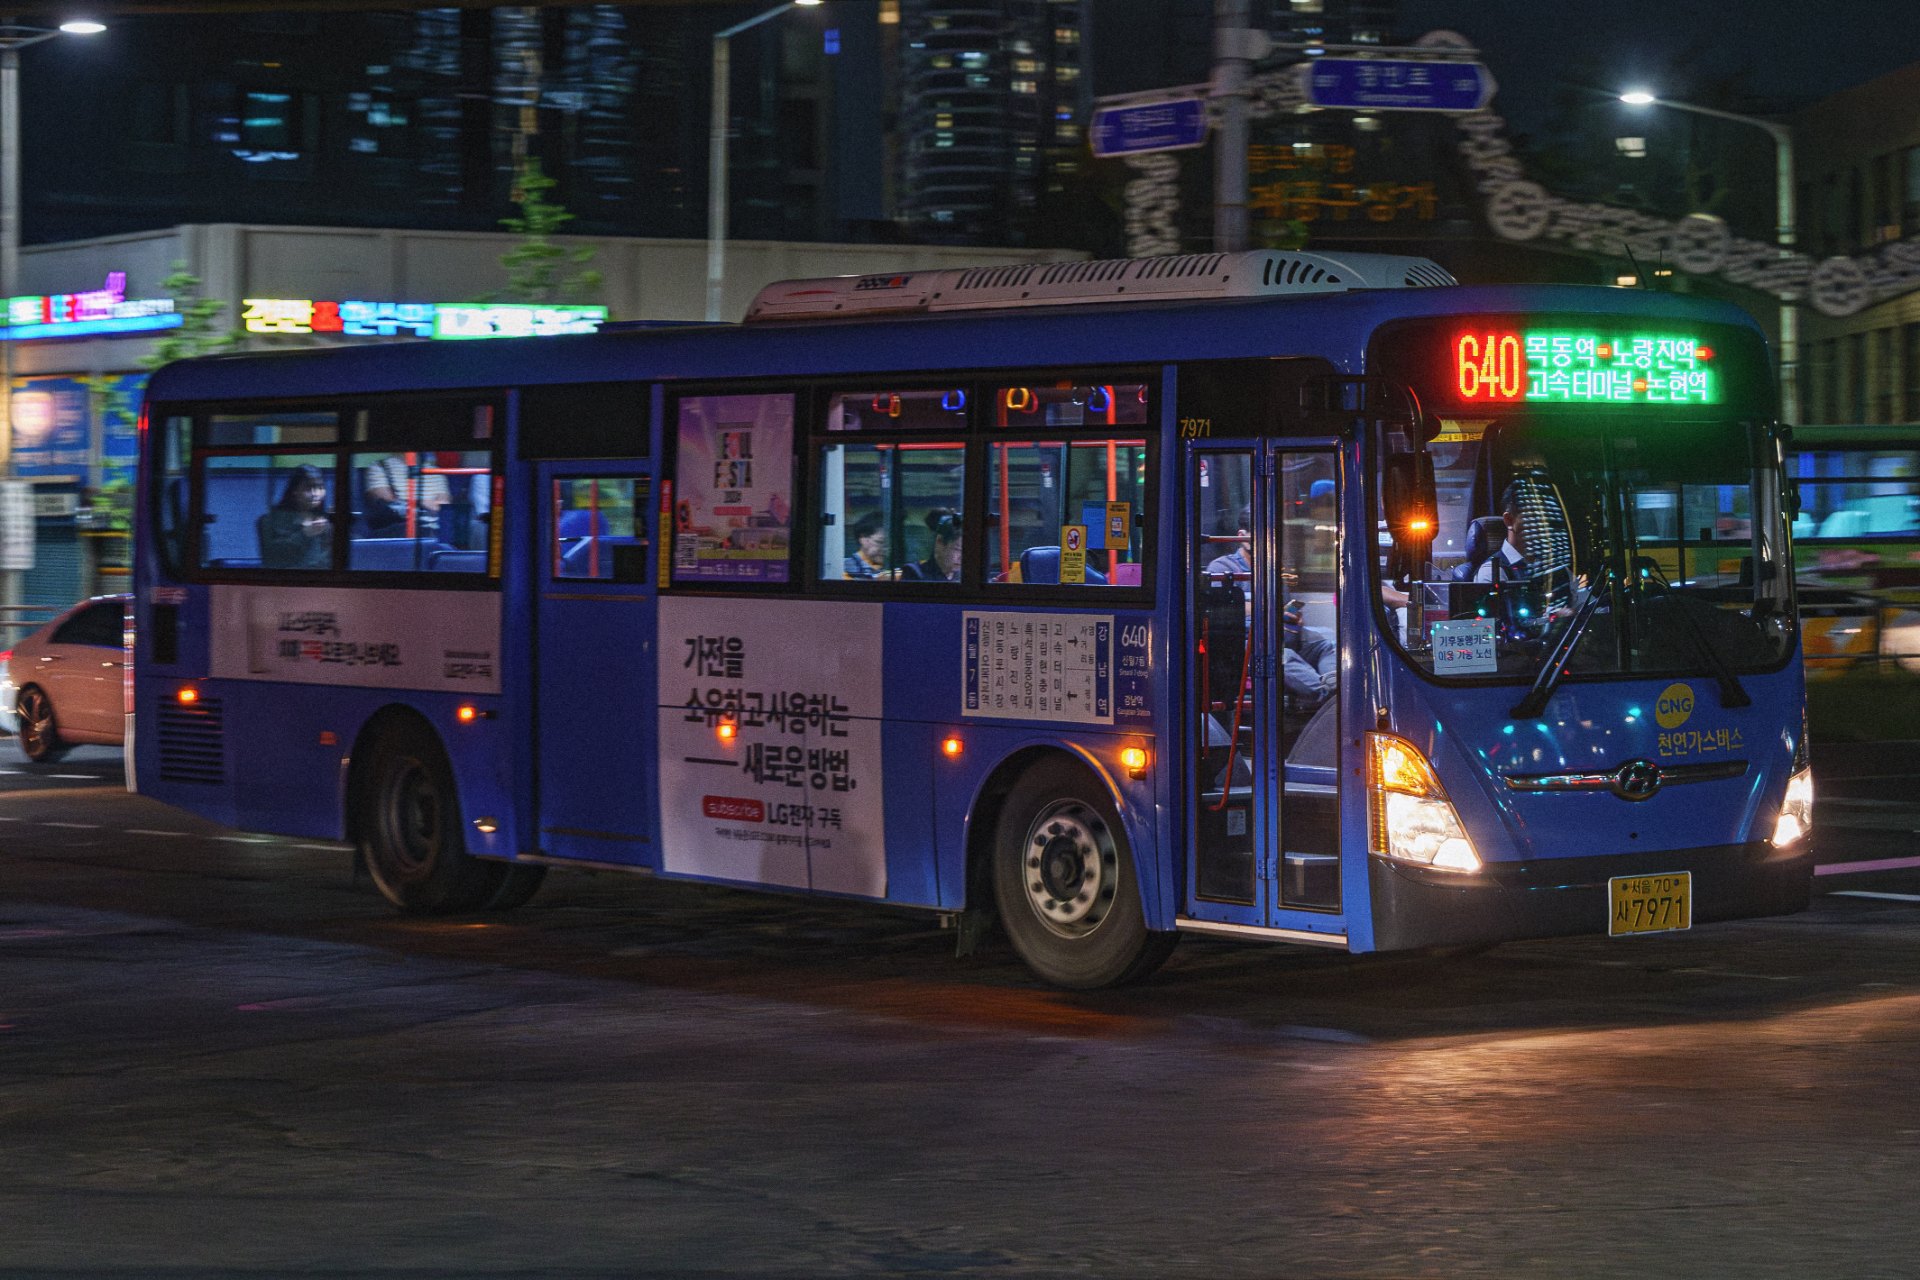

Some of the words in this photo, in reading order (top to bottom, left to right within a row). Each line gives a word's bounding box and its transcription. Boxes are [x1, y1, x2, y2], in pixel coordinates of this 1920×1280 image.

[1458, 335, 1520, 398] 640
[1526, 336, 1595, 368] 목동역
[1611, 338, 1696, 370] 노량진역
[1526, 370, 1632, 400] 고속터미널
[1646, 372, 1707, 401] 논현역
[1180, 418, 1211, 437] 7971
[1121, 625, 1147, 647] 640
[1439, 634, 1490, 647] 기후동행카드
[684, 635, 745, 679] 가전을
[967, 619, 977, 708] 신월7동
[995, 621, 1005, 708] 영등포시장
[1009, 622, 1019, 708] 노량진역
[1053, 623, 1063, 711] 고속터미널
[1122, 655, 1145, 667] 신월7동
[1438, 650, 1454, 661] 이용
[1457, 649, 1473, 660] 가능
[1476, 648, 1492, 659] 노선
[1098, 625, 1108, 715] 강남역
[1124, 695, 1144, 707] 강남역
[1658, 697, 1693, 715] CNG
[1658, 728, 1744, 757] 천연가스버스
[743, 743, 804, 788] 새로운
[767, 802, 814, 828] LG전자
[818, 807, 842, 830] 구독
[1631, 880, 1651, 894] 서울
[1653, 878, 1671, 893] 70
